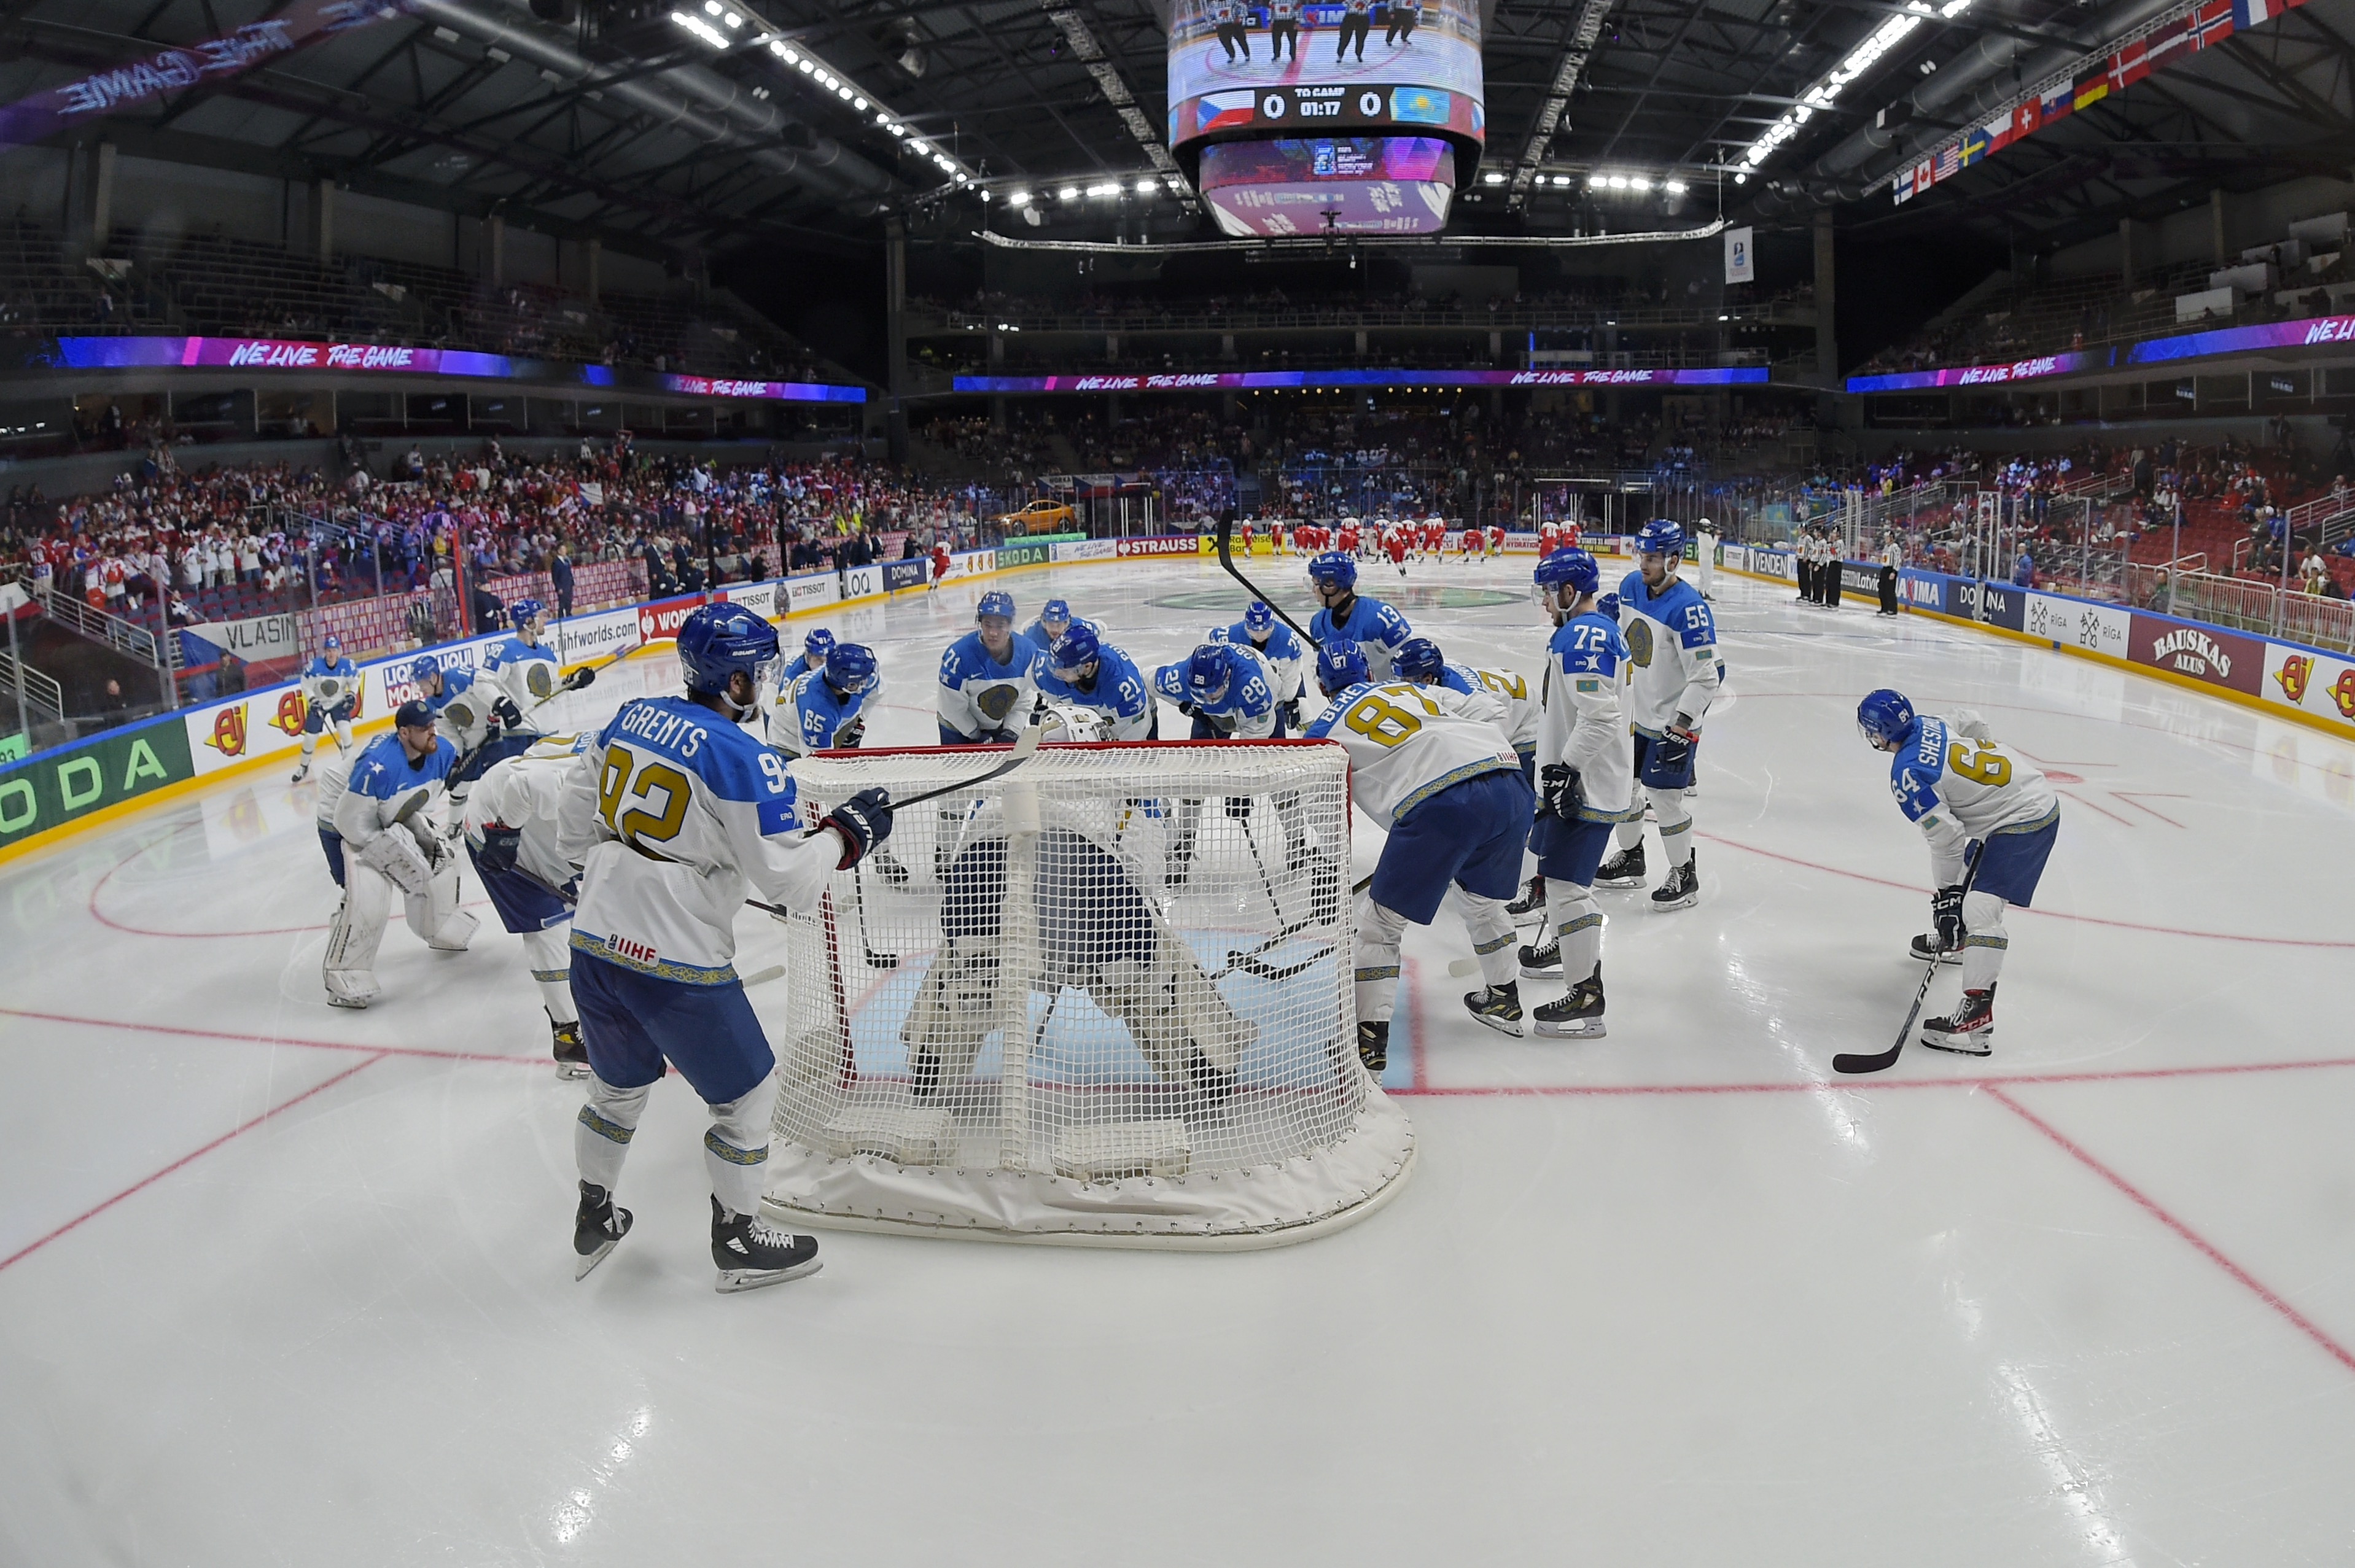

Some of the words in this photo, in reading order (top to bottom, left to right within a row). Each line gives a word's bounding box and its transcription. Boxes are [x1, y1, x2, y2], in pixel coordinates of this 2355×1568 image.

[1294, 88, 1311, 97] TO
[1360, 91, 1382, 117] 0
[1263, 93, 1285, 119] 0
[1300, 101, 1341, 116] 01:17
[2305, 319, 2338, 345] WE
[229, 341, 270, 367] WE
[267, 344, 318, 367] LIVE
[326, 343, 364, 367] THE
[362, 345, 413, 368] GAME
[1075, 377, 1105, 391] WE
[1101, 377, 1138, 390] LIVE
[1146, 374, 1175, 388] THE
[1174, 373, 1218, 387] GAME
[1510, 371, 1540, 385] WE
[1536, 371, 1575, 384] LIVE
[1582, 370, 1612, 382] THE
[1610, 370, 1653, 382] GAME
[1959, 368, 1983, 386] WE
[1980, 367, 2009, 383] LIVE
[2012, 361, 2030, 379] THE
[2029, 356, 2057, 376] GAME
[710, 379, 733, 395] THE
[731, 380, 768, 397] GAME
[1131, 538, 1197, 554] STRAUSS
[891, 564, 919, 581] DOMINA
[1754, 551, 1788, 576] VENDEN
[802, 581, 826, 596] TISSOT
[846, 572, 871, 596] OQ
[742, 592, 771, 608] TISSOT
[1960, 585, 2006, 613] DOINA
[1376, 604, 1401, 629] 13
[1685, 604, 1710, 629] 55
[2050, 613, 2068, 628] RĪGA
[2102, 625, 2122, 641] RĪGA
[1573, 624, 1607, 653] 72
[437, 648, 473, 672] LIQUI
[731, 648, 757, 657] BAUER
[943, 648, 961, 675] 71
[1333, 655, 1347, 670] 87
[2152, 629, 2232, 678] BAUSKAS
[2173, 653, 2206, 676] ALUS
[1118, 675, 1142, 702] 21
[1165, 669, 1183, 697] 28
[1194, 674, 1205, 685] 28
[1241, 676, 1267, 704] 28
[804, 710, 827, 733] 65
[1344, 684, 1447, 748] 87
[621, 703, 707, 758] GRENTS
[599, 743, 693, 843] 92
[1891, 767, 1921, 804] 64
[780, 812, 793, 821] ERG
[842, 804, 873, 858] AUER
[618, 937, 656, 963] IIHF
[1955, 1014, 1991, 1034] CCM
